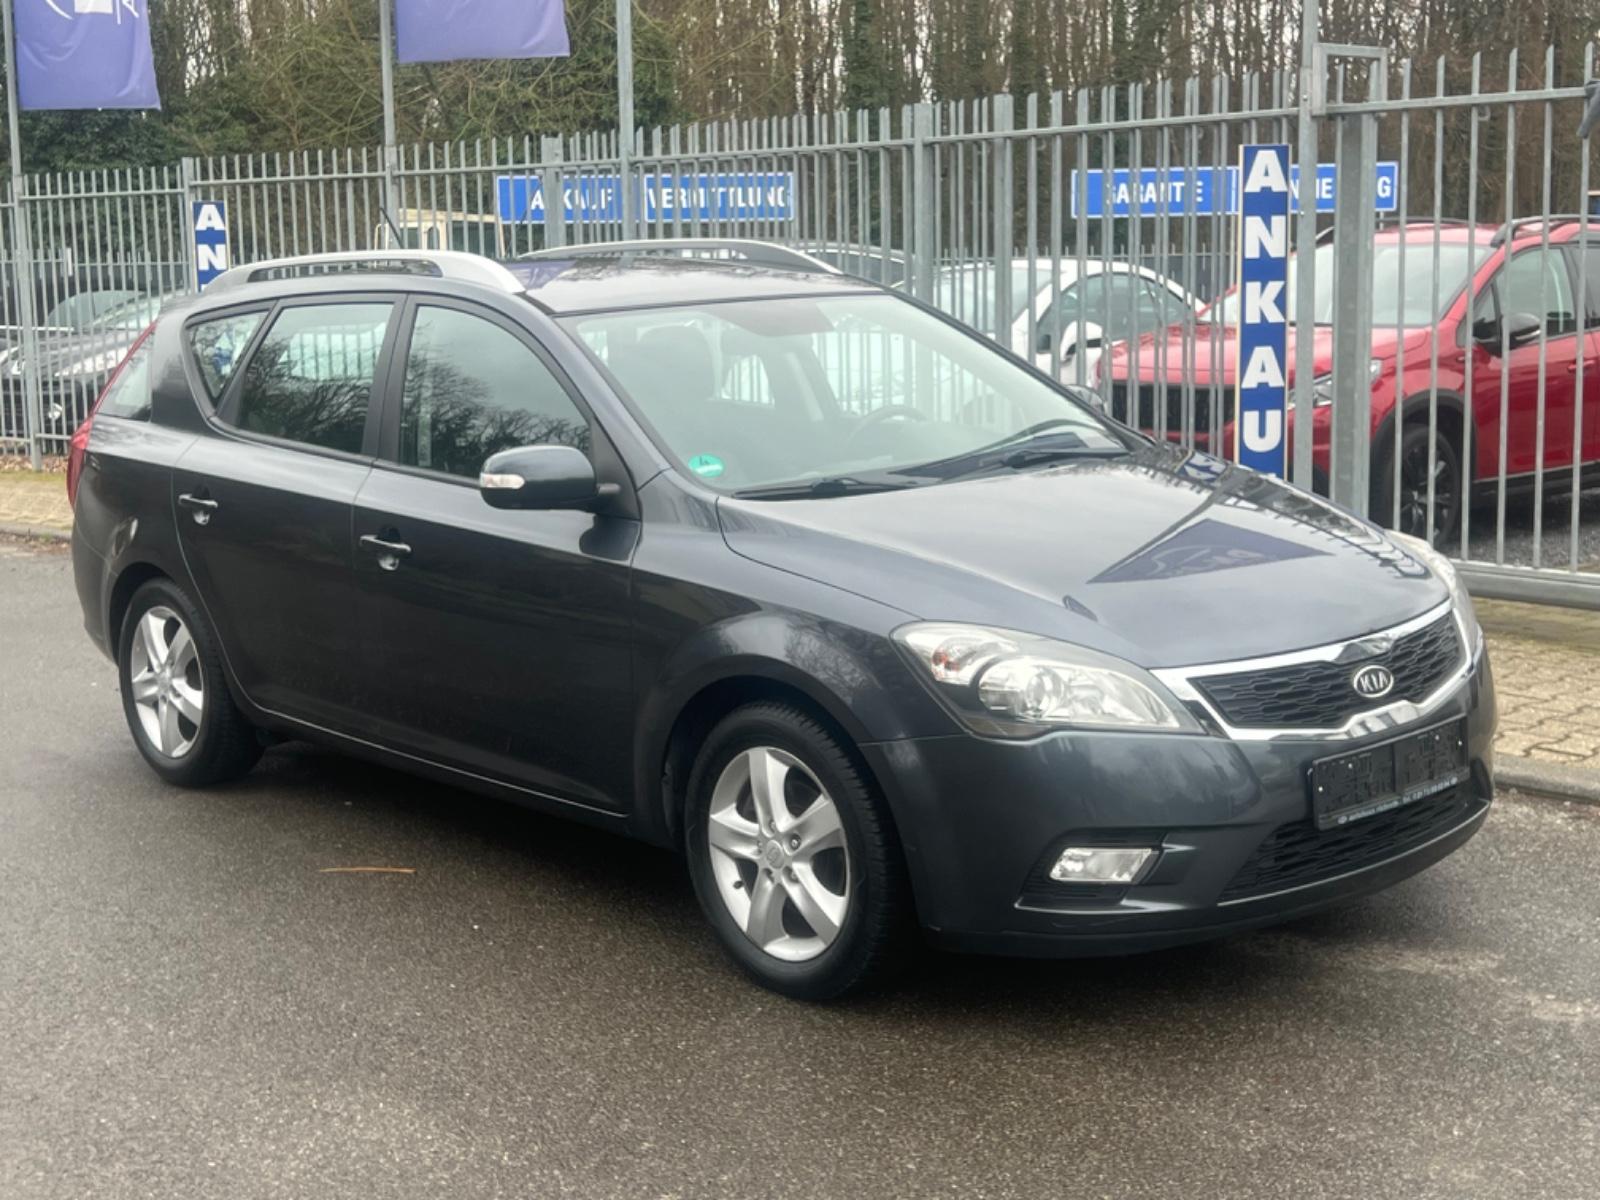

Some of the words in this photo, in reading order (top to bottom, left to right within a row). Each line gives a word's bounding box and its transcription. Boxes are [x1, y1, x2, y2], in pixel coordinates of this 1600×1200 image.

[195, 204, 228, 288] AN
[1241, 149, 1288, 475] ANKAU
[1360, 670, 1388, 692] KIA
